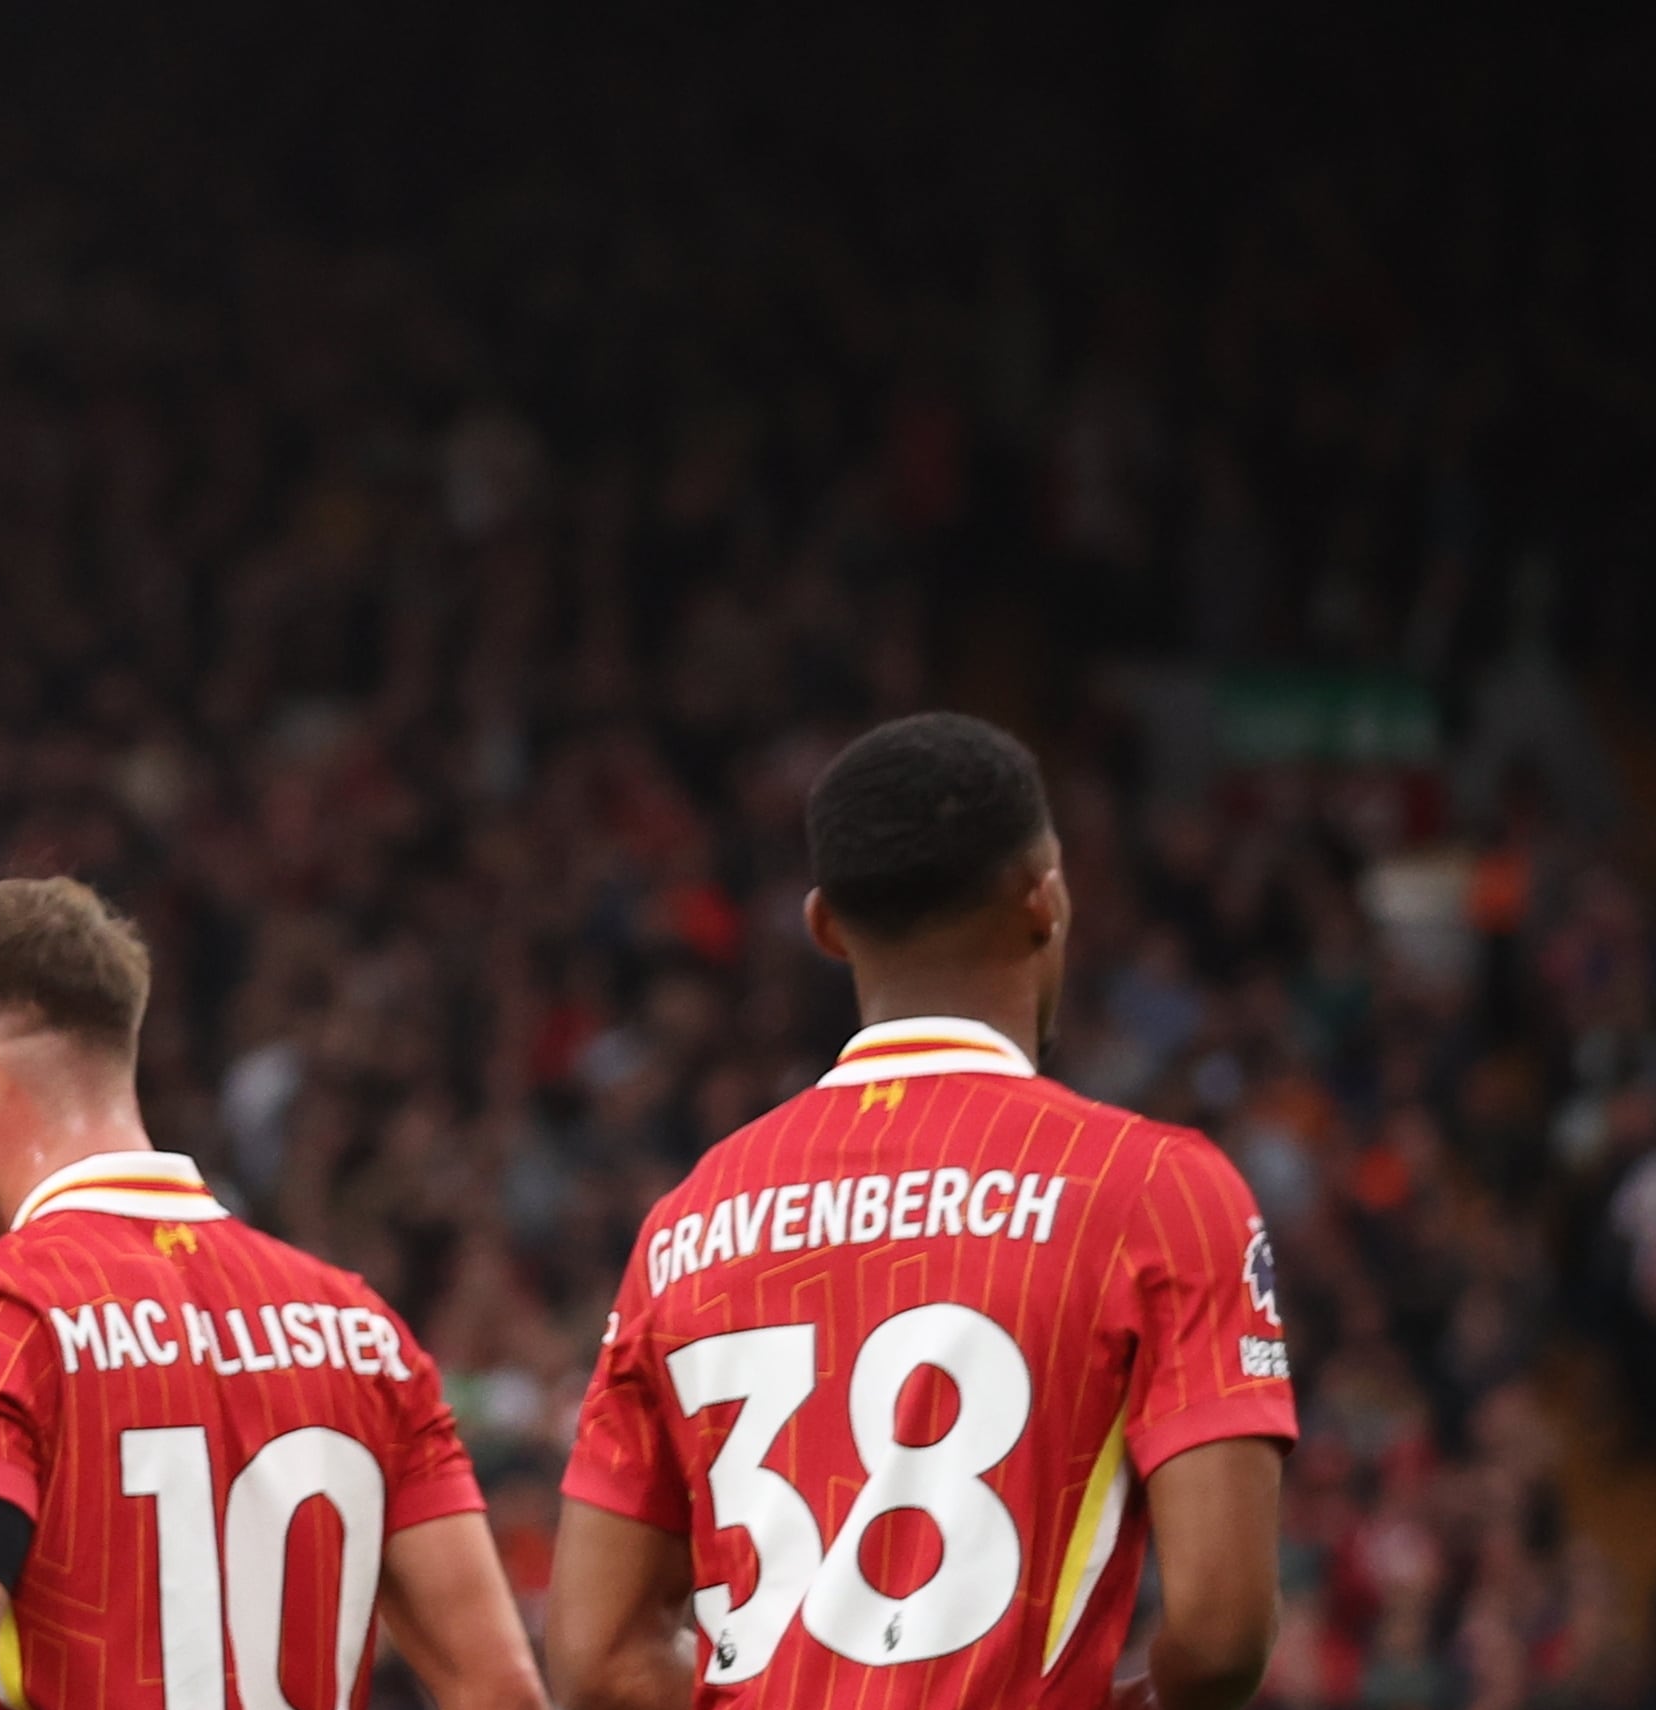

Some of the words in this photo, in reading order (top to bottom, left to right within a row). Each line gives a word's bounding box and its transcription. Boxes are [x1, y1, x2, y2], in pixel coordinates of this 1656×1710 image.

[647, 1166, 1067, 1298] GRAVENBERCH
[49, 1298, 179, 1375] MAC
[665, 1302, 1033, 1686] 38
